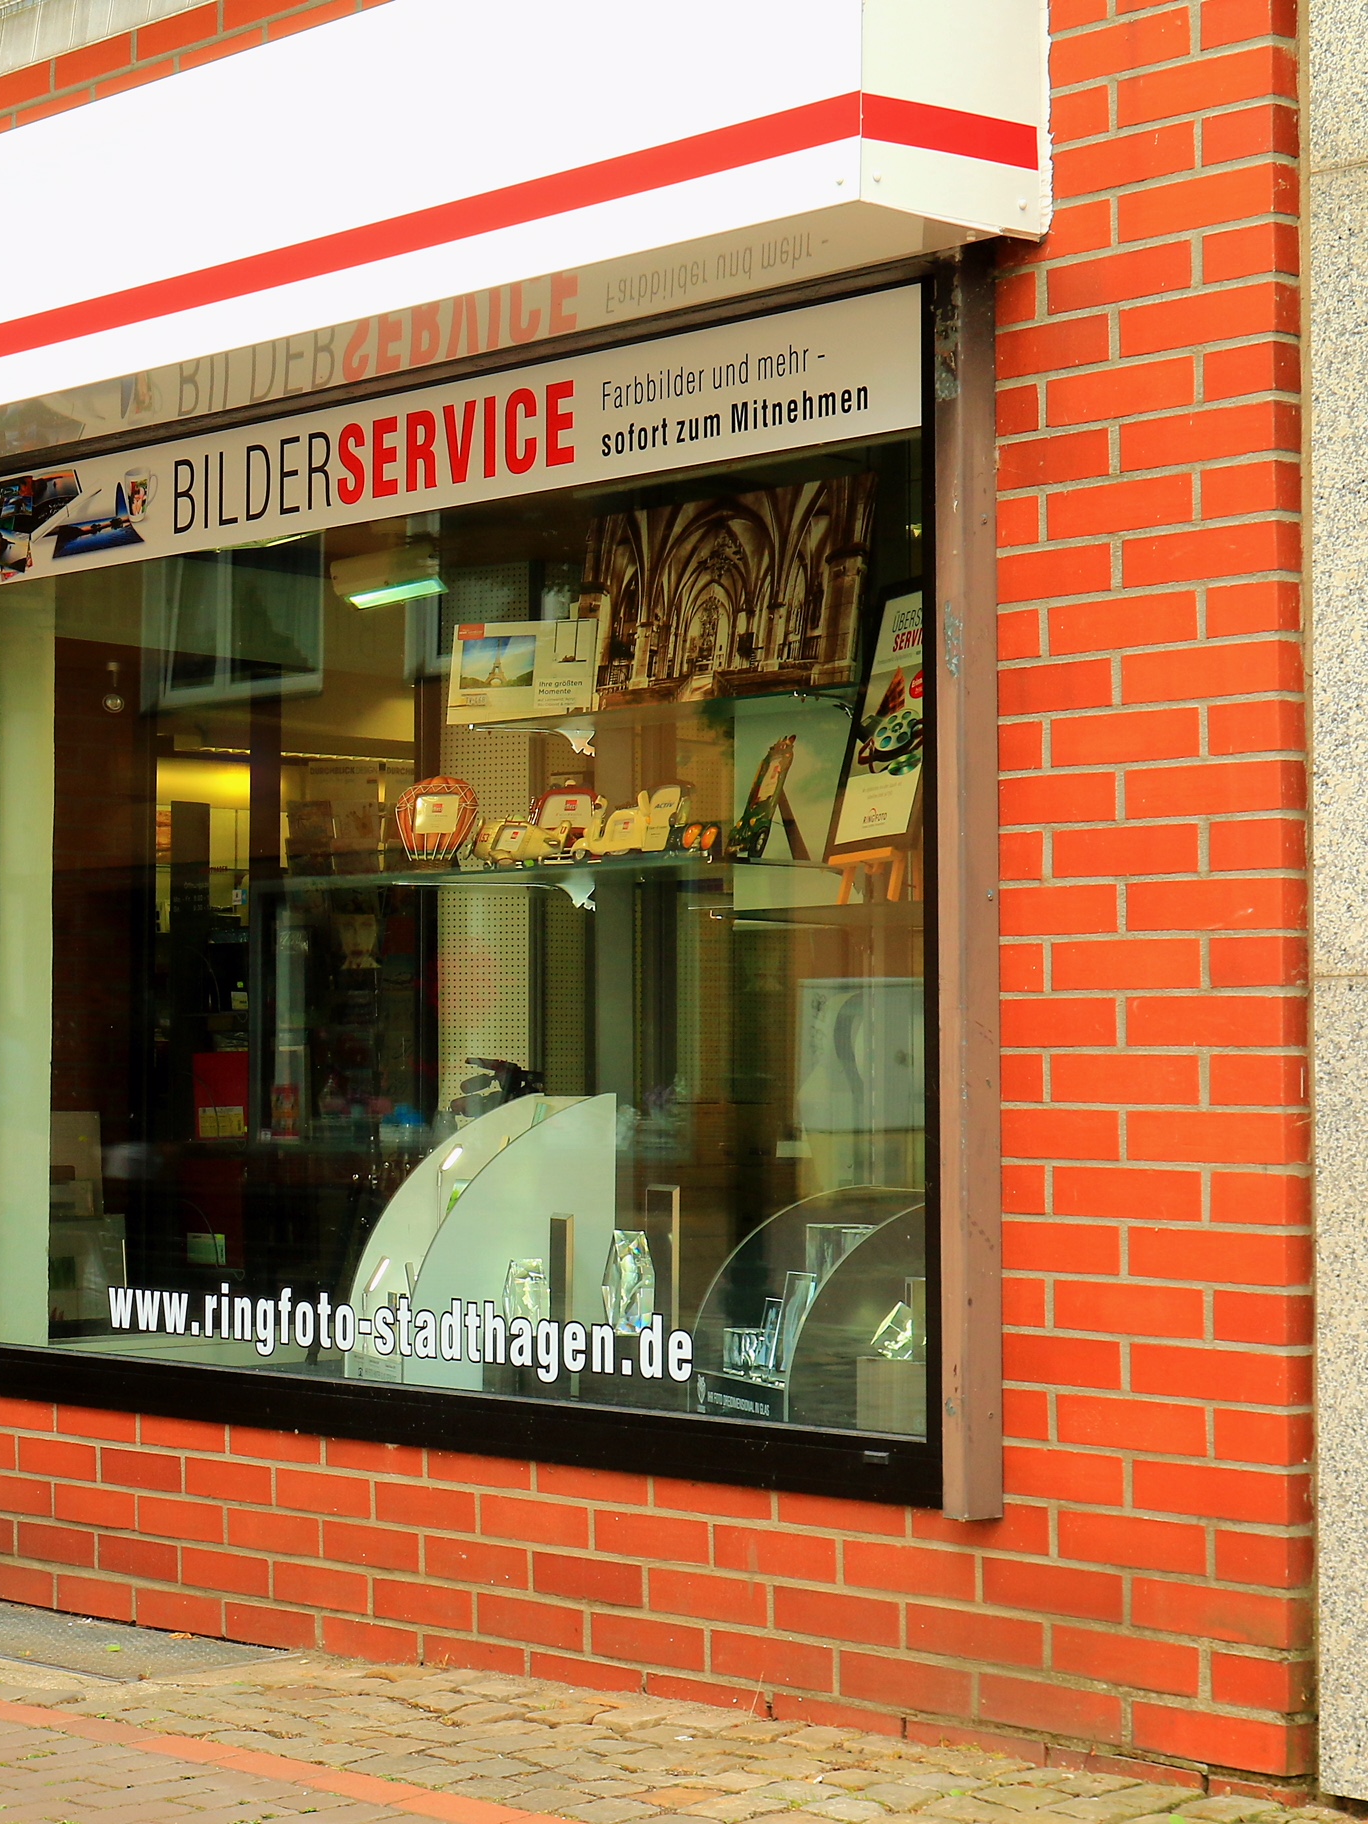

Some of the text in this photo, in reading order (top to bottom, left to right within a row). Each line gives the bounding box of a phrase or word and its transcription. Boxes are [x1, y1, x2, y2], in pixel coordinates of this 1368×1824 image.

[601, 364, 706, 411] Farbbilder
[712, 356, 752, 391] und
[756, 346, 810, 381] mehr
[601, 382, 870, 458] sofort zum Mitnehmen
[891, 608, 923, 633] ÜBERS
[554, 679, 583, 689] größten
[107, 1282, 694, 1384] www.ringfoto-stadthagen.de
